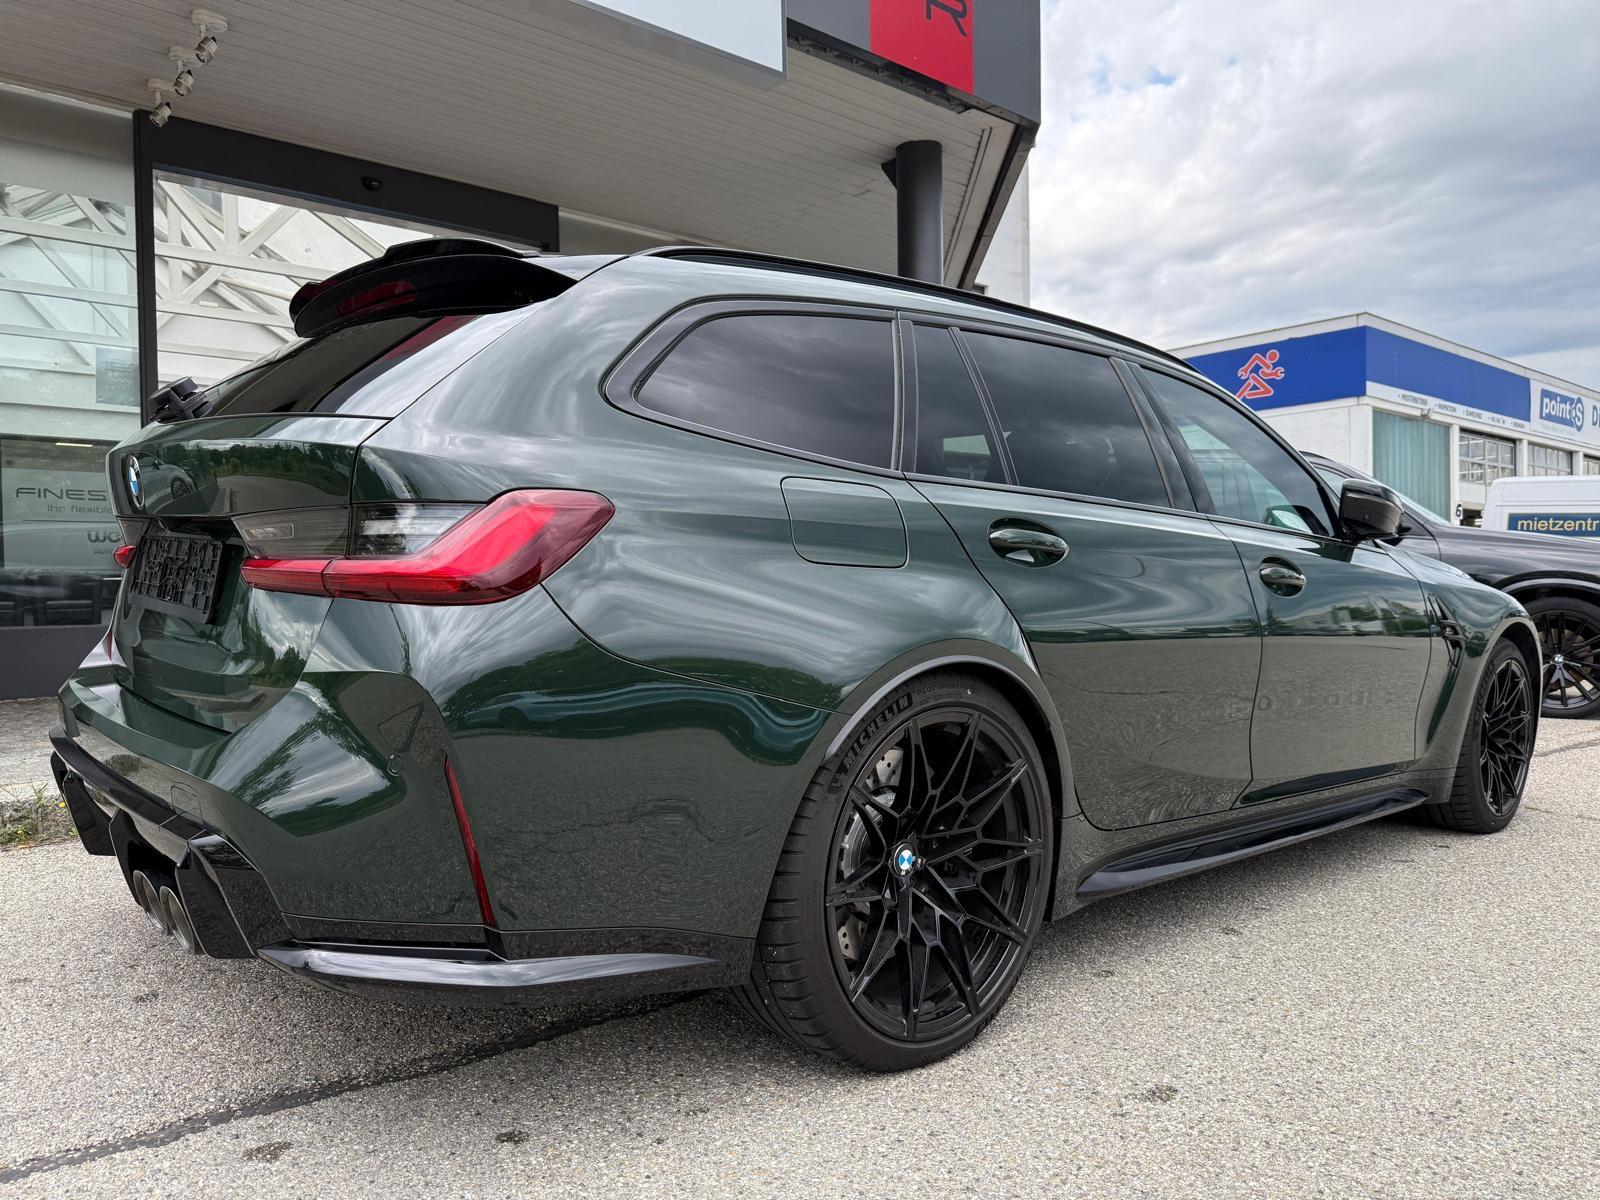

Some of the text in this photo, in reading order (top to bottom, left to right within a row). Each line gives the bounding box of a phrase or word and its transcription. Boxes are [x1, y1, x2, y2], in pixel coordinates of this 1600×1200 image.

[1542, 396, 1571, 420] point
[16, 487, 107, 502] FINES
[1455, 503, 1463, 518] 6
[1517, 516, 1600, 532] mietzentr
[841, 694, 911, 771] MICHELIN
